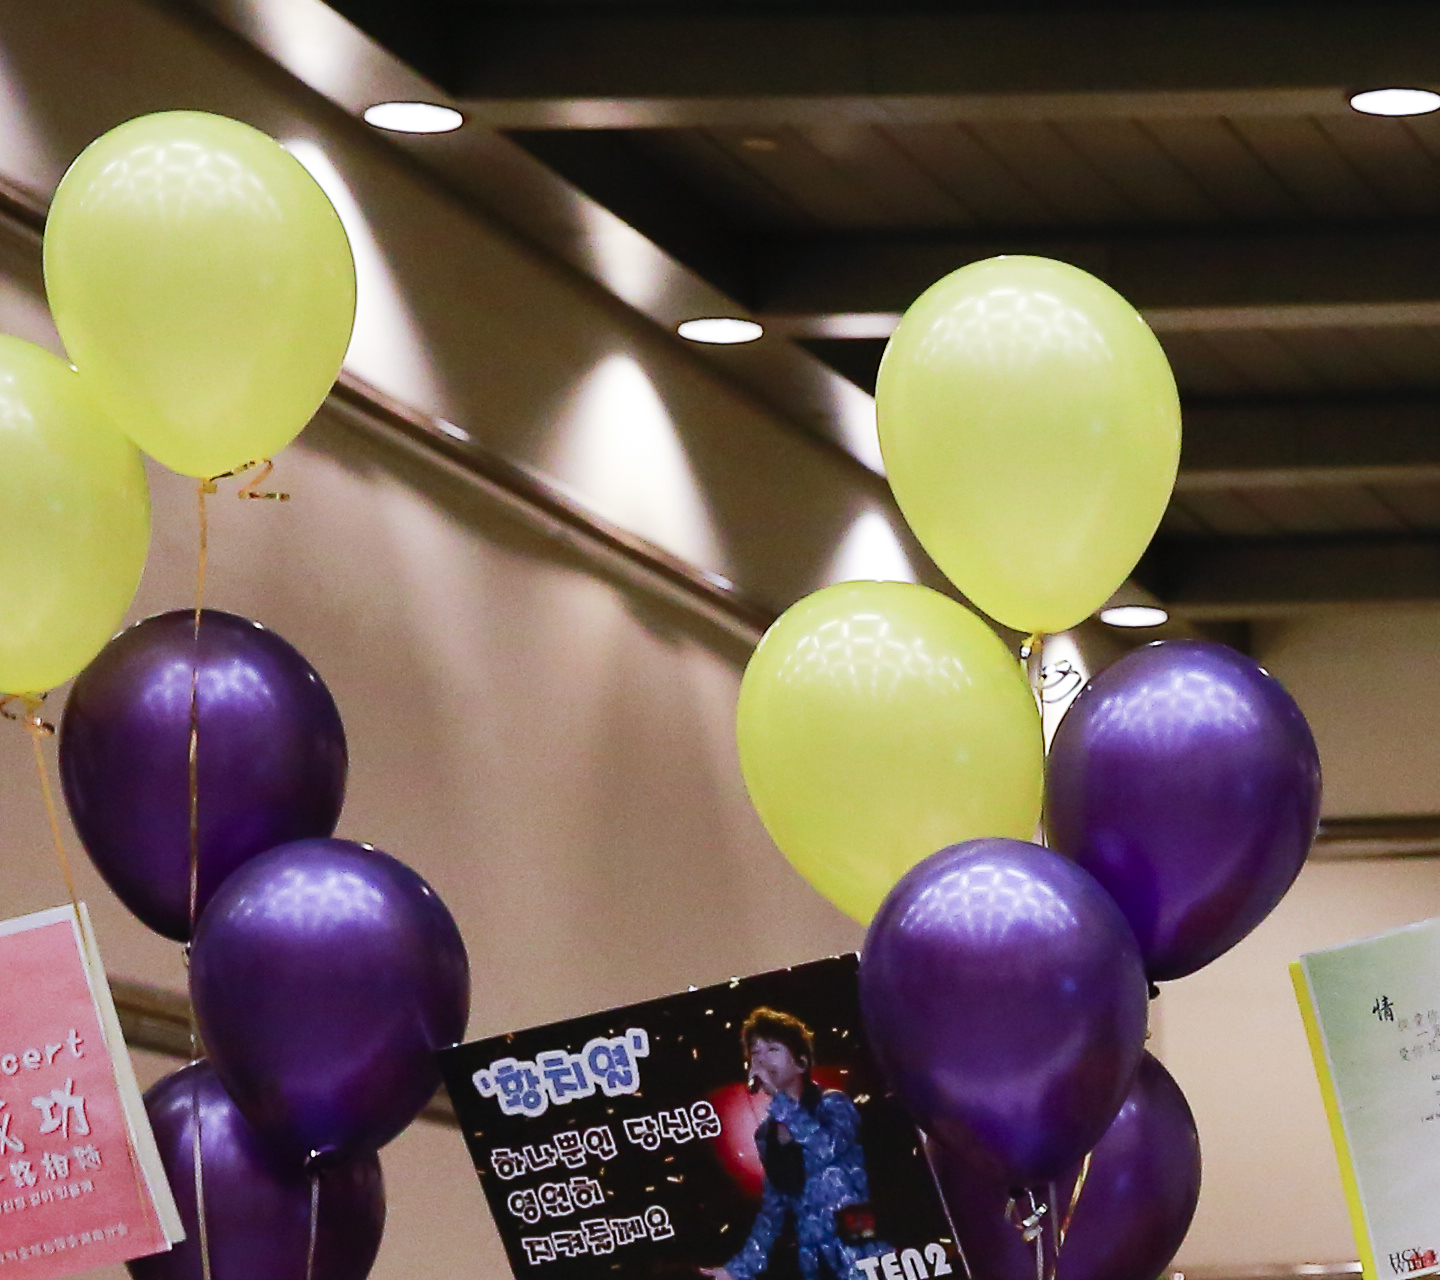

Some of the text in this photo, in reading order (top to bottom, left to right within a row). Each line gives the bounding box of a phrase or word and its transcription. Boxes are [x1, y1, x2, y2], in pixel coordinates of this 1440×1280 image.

[1372, 995, 1394, 1022] 情
[491, 1101, 721, 1179] 하나뿐인 당신을
[507, 1177, 604, 1223] 영원히
